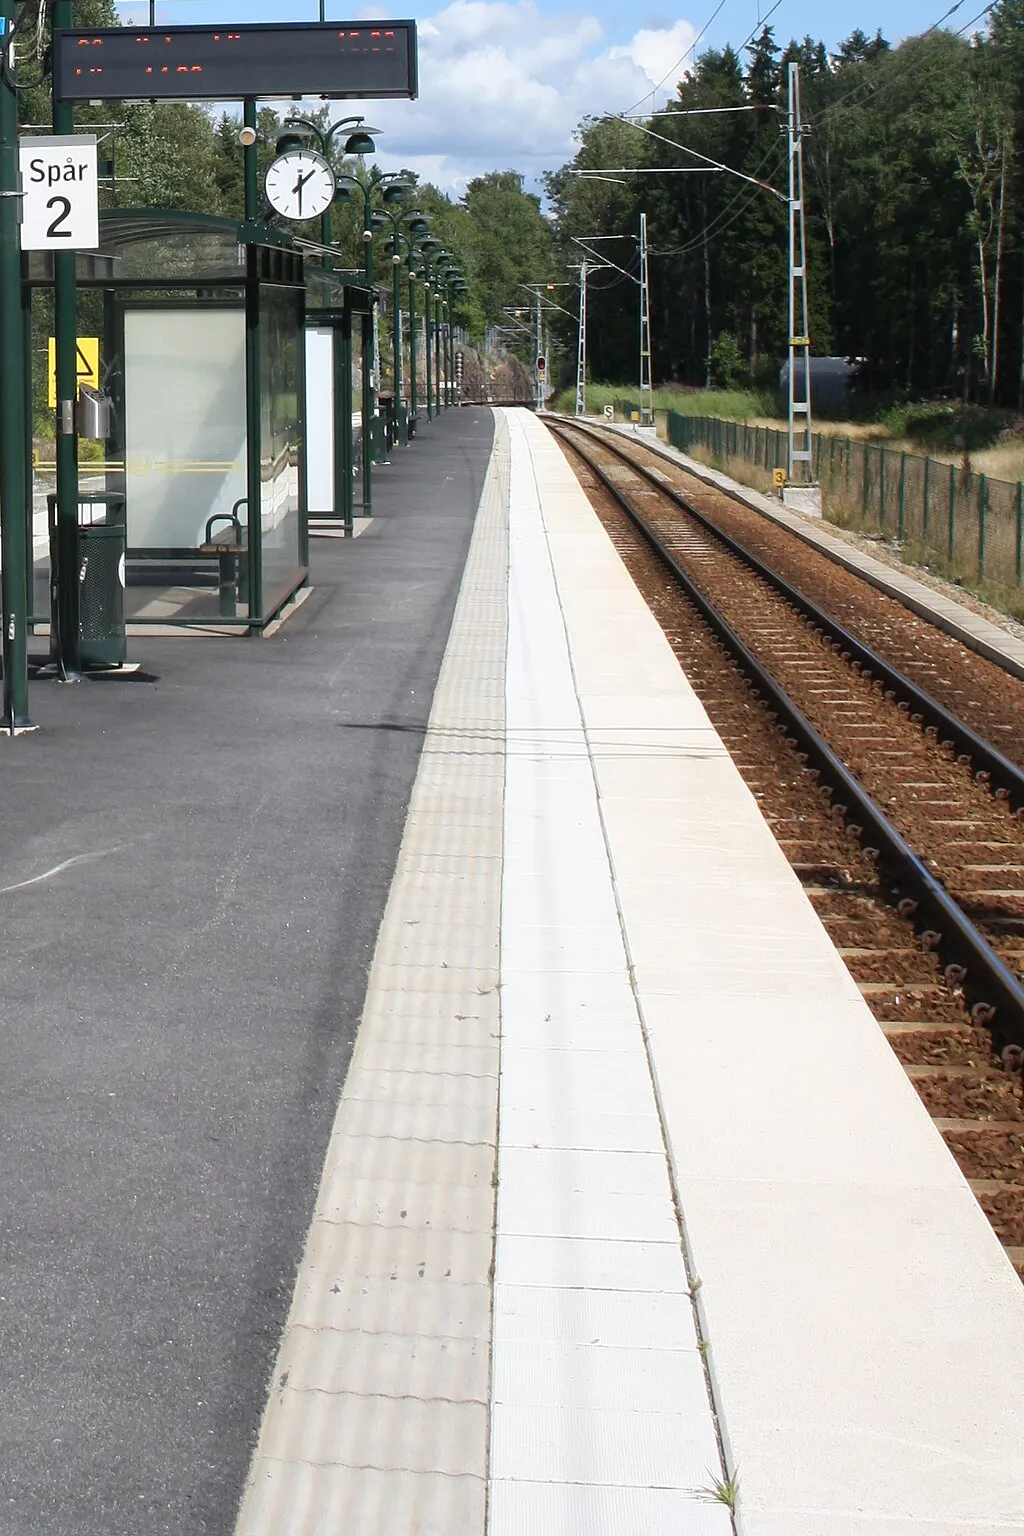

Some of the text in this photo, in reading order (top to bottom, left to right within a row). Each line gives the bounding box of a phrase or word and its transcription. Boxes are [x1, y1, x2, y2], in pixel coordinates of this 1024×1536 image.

[29, 156, 89, 185] Spår
[45, 195, 73, 238] 2
[605, 406, 613, 418] S
[775, 471, 783, 483] 3
